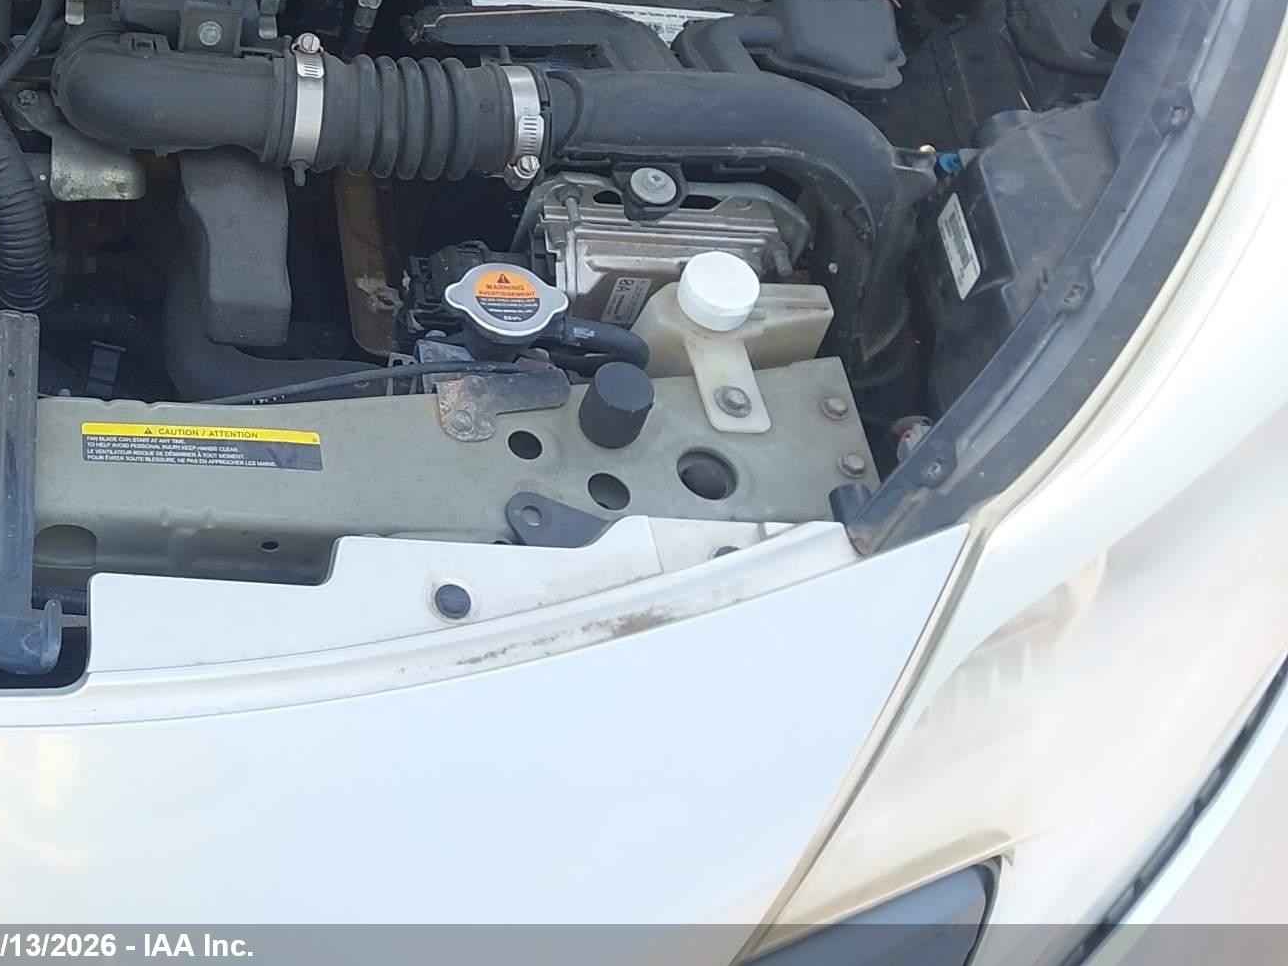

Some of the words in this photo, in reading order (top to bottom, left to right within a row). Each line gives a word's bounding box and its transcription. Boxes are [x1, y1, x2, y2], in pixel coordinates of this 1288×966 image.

[486, 283, 525, 291] WARNING
[158, 428, 198, 436] CAUTION
[208, 430, 258, 438] ATTENTION
